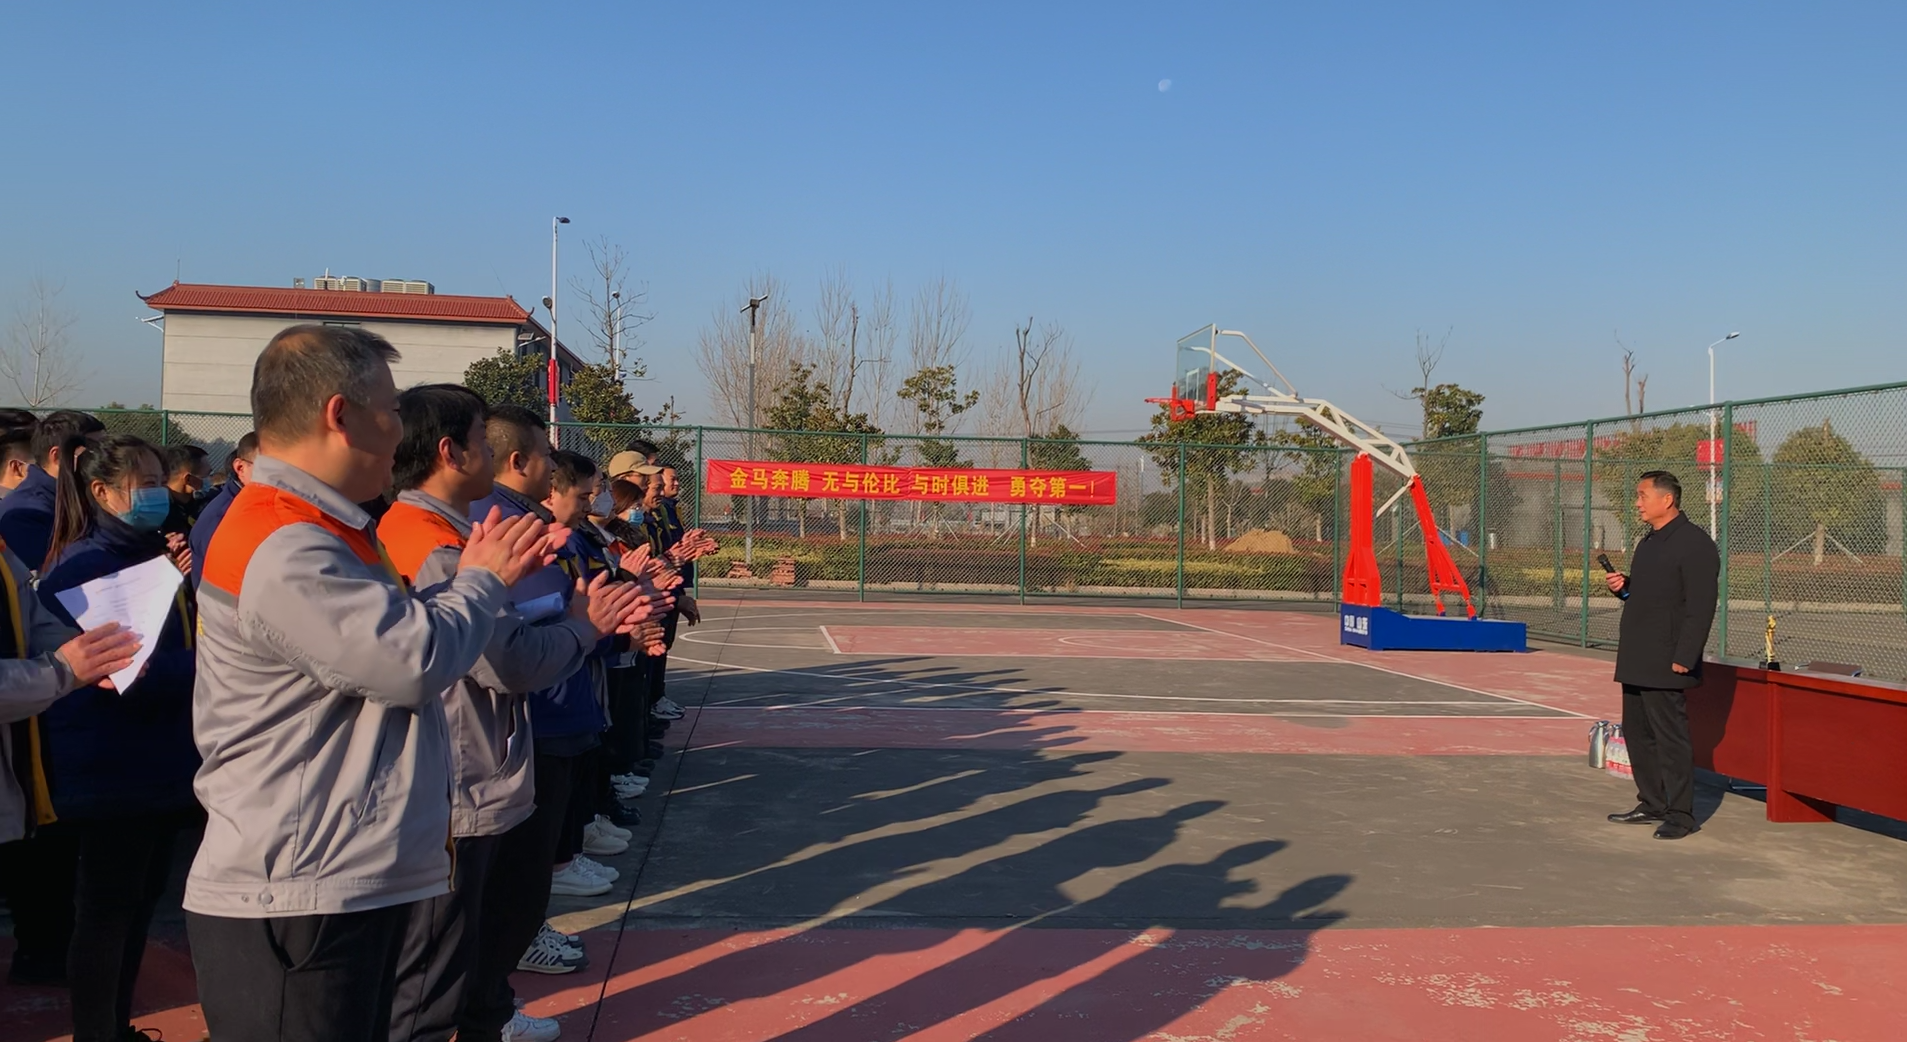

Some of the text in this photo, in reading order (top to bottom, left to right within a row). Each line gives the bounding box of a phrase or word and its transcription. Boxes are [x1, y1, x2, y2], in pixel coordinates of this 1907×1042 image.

[729, 466, 811, 492] 金马奔腾
[821, 471, 901, 494] 无与伦比
[911, 473, 990, 496] 与时俱进
